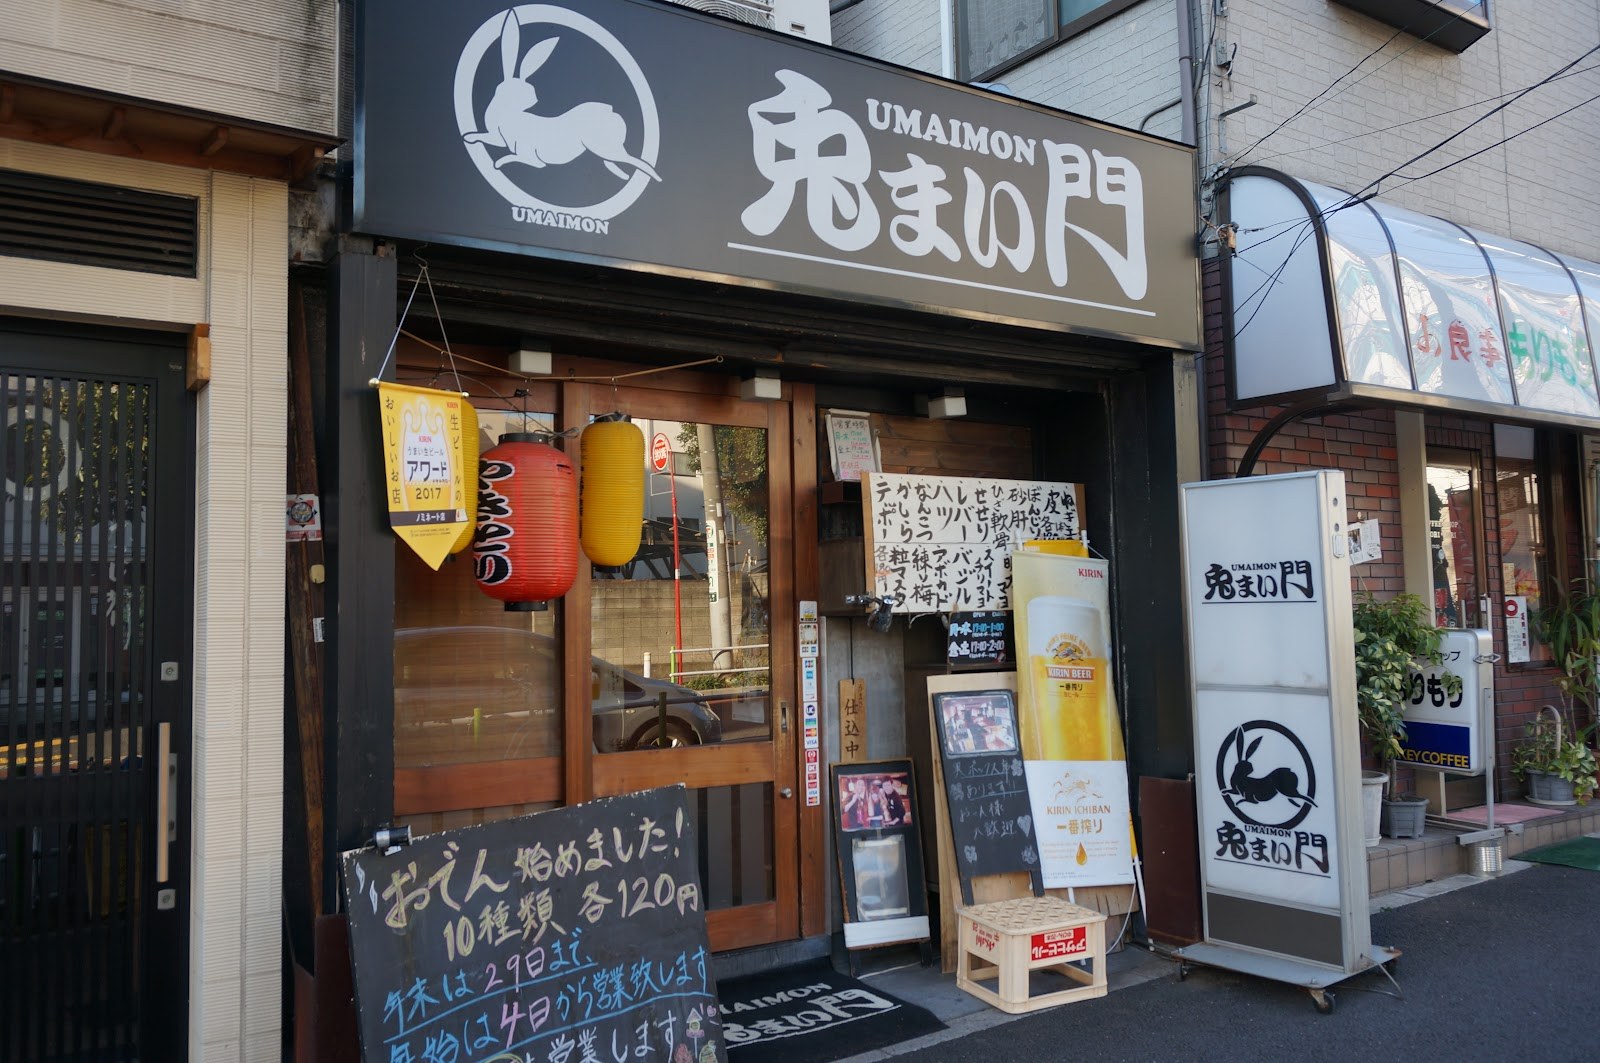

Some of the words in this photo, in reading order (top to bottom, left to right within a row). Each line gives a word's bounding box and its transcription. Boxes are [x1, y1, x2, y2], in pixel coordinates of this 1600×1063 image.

[866, 97, 1037, 166] UMAIMON
[511, 206, 610, 235] UMAIMON
[385, 396, 401, 505] おいしいお店
[407, 446, 444, 457] うまい生ビール
[450, 414, 462, 502] 生ビールの
[407, 460, 447, 482] アワード
[415, 487, 441, 500] 2017
[933, 481, 954, 531] ハツ
[1008, 486, 1028, 532] 砂肝
[1043, 489, 1061, 515] 皮
[415, 512, 446, 523] ノミネート店
[897, 481, 913, 543] かしら
[914, 482, 934, 541] なんこつ
[954, 484, 975, 542] レバー
[974, 487, 990, 543] せせり
[933, 548, 952, 608] アボカド
[952, 549, 975, 604] バジル
[1078, 568, 1104, 579] KIRIN
[1231, 563, 1277, 571] UMAIMON
[1048, 667, 1070, 678] KIRIN
[1071, 668, 1091, 679] BEER
[1401, 673, 1463, 708] りもり
[844, 698, 860, 759] 仕込中
[1421, 751, 1470, 768] COFFEE
[1047, 806, 1071, 815] KIRIN
[1075, 805, 1111, 814] ICHIBAN
[1057, 819, 1103, 835] 一番搾り
[1244, 825, 1292, 838] UMAIMON
[444, 888, 566, 961] 10種類
[1032, 938, 1086, 960] アサヒビール
[718, 982, 833, 1015] AIMON
